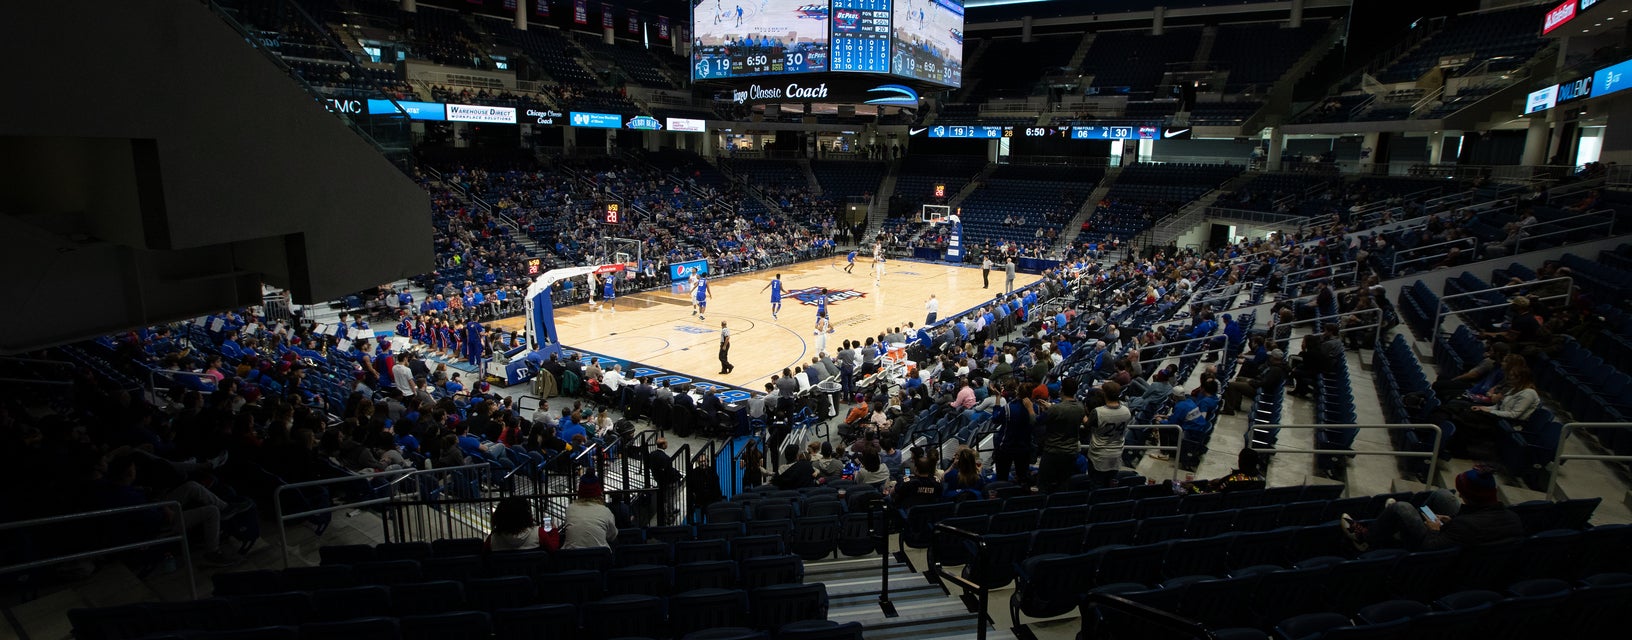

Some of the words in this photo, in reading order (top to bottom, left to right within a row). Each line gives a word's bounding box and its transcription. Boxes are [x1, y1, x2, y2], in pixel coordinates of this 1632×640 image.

[716, 59, 730, 70] 19
[746, 55, 767, 66] 6:50
[786, 53, 803, 66] 30
[906, 58, 915, 70] 19
[924, 62, 936, 72] 6:50
[943, 67, 952, 79] 30
[750, 84, 781, 100] Classic
[786, 83, 828, 98] Coach
[450, 106, 487, 115] WAREHOUSE
[526, 109, 547, 117] Chicago
[954, 128, 963, 136] 19
[1026, 128, 1045, 136] 6:50
[1115, 129, 1127, 137] 30
[608, 204, 619, 212] 6:50
[607, 211, 617, 222] 28
[529, 266, 538, 274] 28
[1102, 422, 1126, 437] 24
